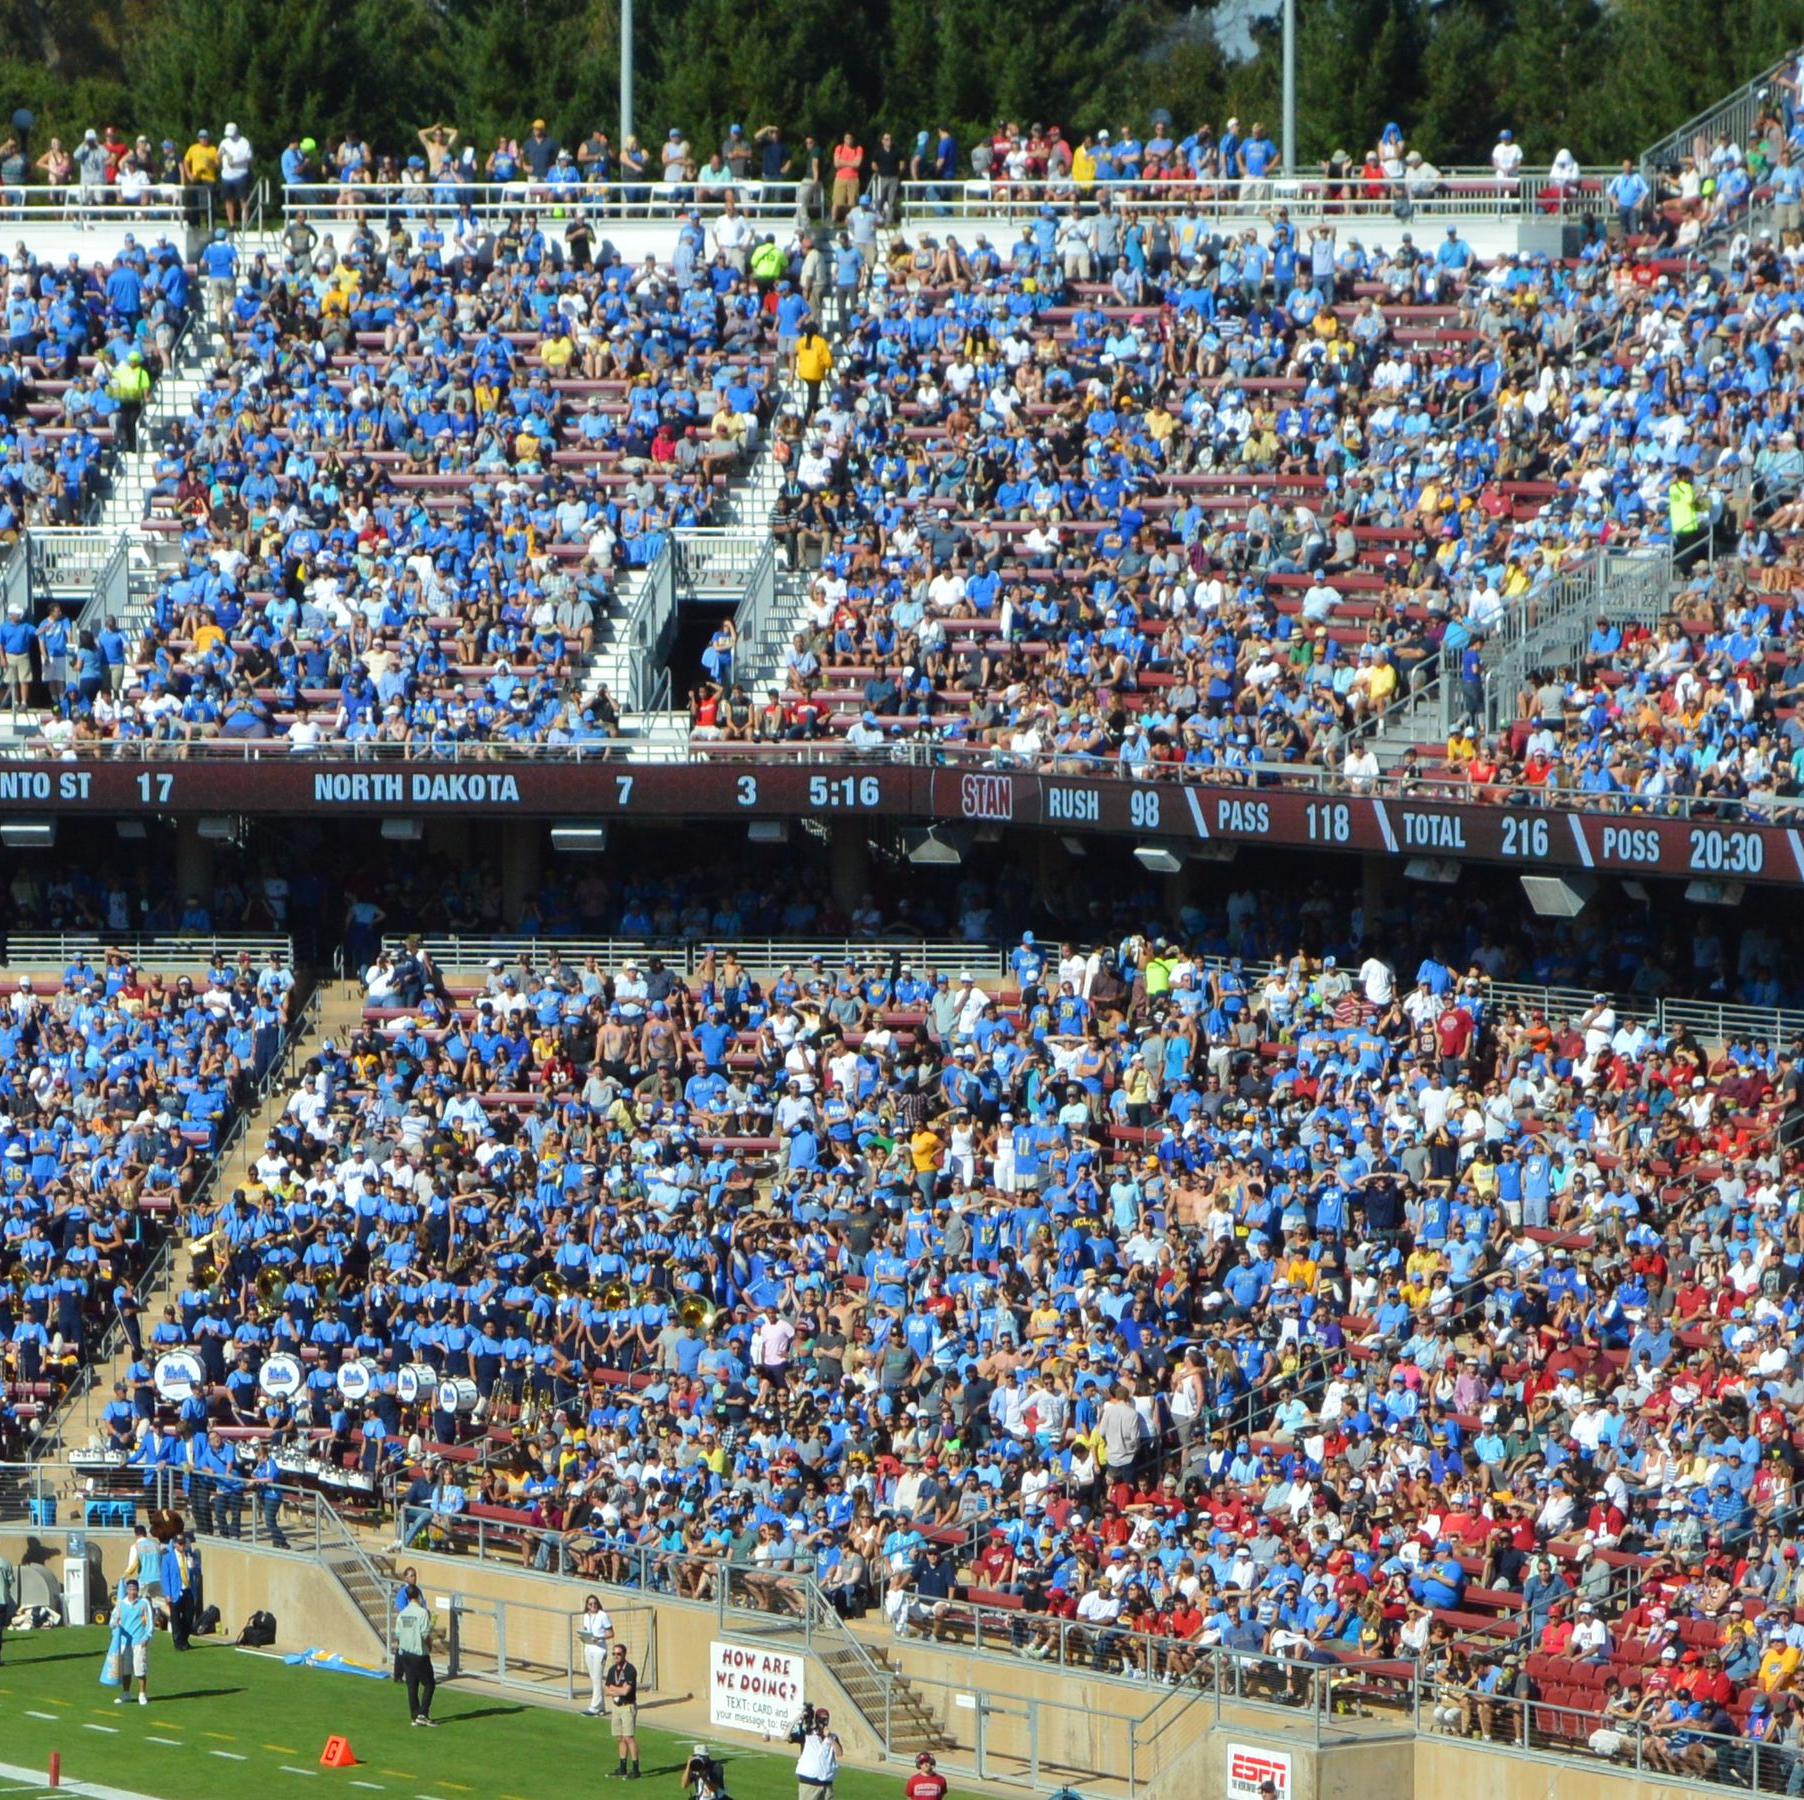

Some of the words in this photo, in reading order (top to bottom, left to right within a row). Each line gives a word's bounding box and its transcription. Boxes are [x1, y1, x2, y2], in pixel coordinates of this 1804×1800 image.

[67, 569, 87, 577] EXIT
[60, 772, 91, 798] ST
[137, 773, 173, 801] 17
[315, 774, 402, 800] NORTH
[413, 774, 519, 800] DAKOTA
[617, 776, 633, 803] 7
[738, 776, 756, 804] 3
[810, 776, 878, 805] 5:16
[962, 774, 1013, 820] STAN
[1050, 788, 1098, 819] RUSH
[1131, 790, 1159, 826] 98
[1219, 800, 1268, 832] PASS
[1307, 804, 1348, 841] 118
[1403, 813, 1465, 847] TOTAL
[1502, 817, 1547, 855] 216
[1604, 828, 1659, 861] POSS
[1691, 830, 1762, 872] 20:30
[723, 1648, 756, 1668] HOW
[762, 1656, 791, 1675] ARE
[716, 1670, 735, 1688] WE
[740, 1674, 797, 1700] DOING?
[726, 1695, 750, 1711] TEXT:
[753, 1702, 773, 1715] CARD
[325, 1740, 340, 1761] G
[1232, 1753, 1286, 1788] ESPN
